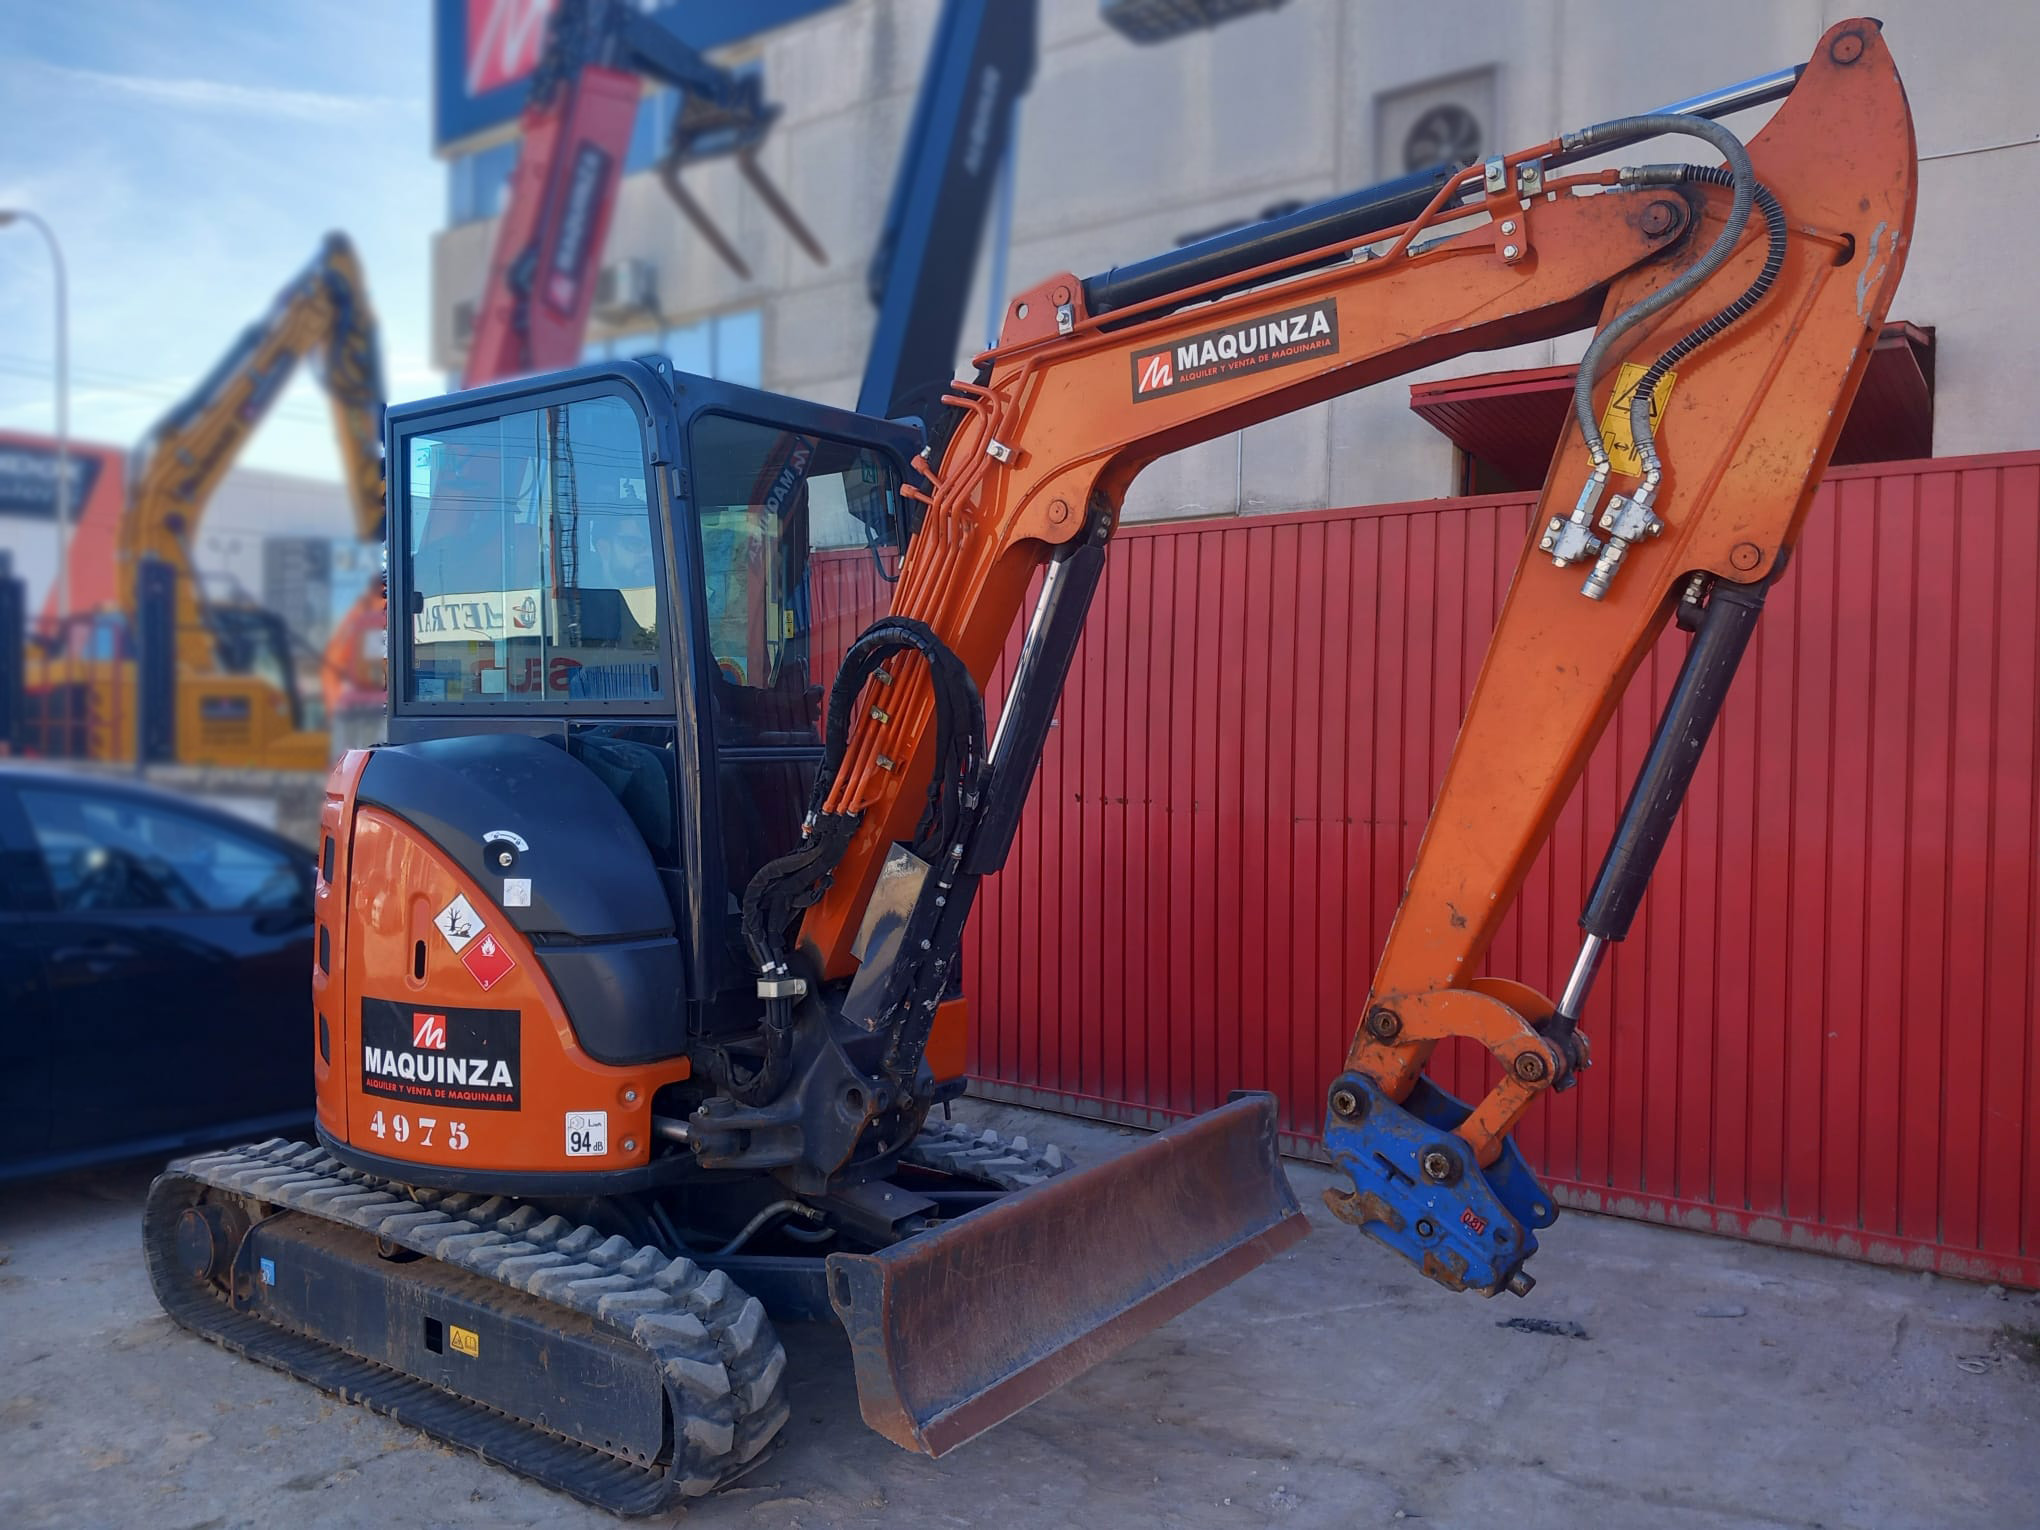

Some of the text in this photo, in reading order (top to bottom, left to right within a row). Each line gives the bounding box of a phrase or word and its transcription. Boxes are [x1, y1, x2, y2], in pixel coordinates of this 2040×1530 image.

[1177, 310, 1331, 371] MAQUINZA
[1179, 338, 1332, 383] ALQUILER Y VENTA DE MAQUINARIA
[365, 1046, 514, 1088] MAQUINZA
[366, 1078, 513, 1103] ALQUILER Y VENTA DE MAQUINARIA
[570, 1131, 604, 1153] 94 dB
